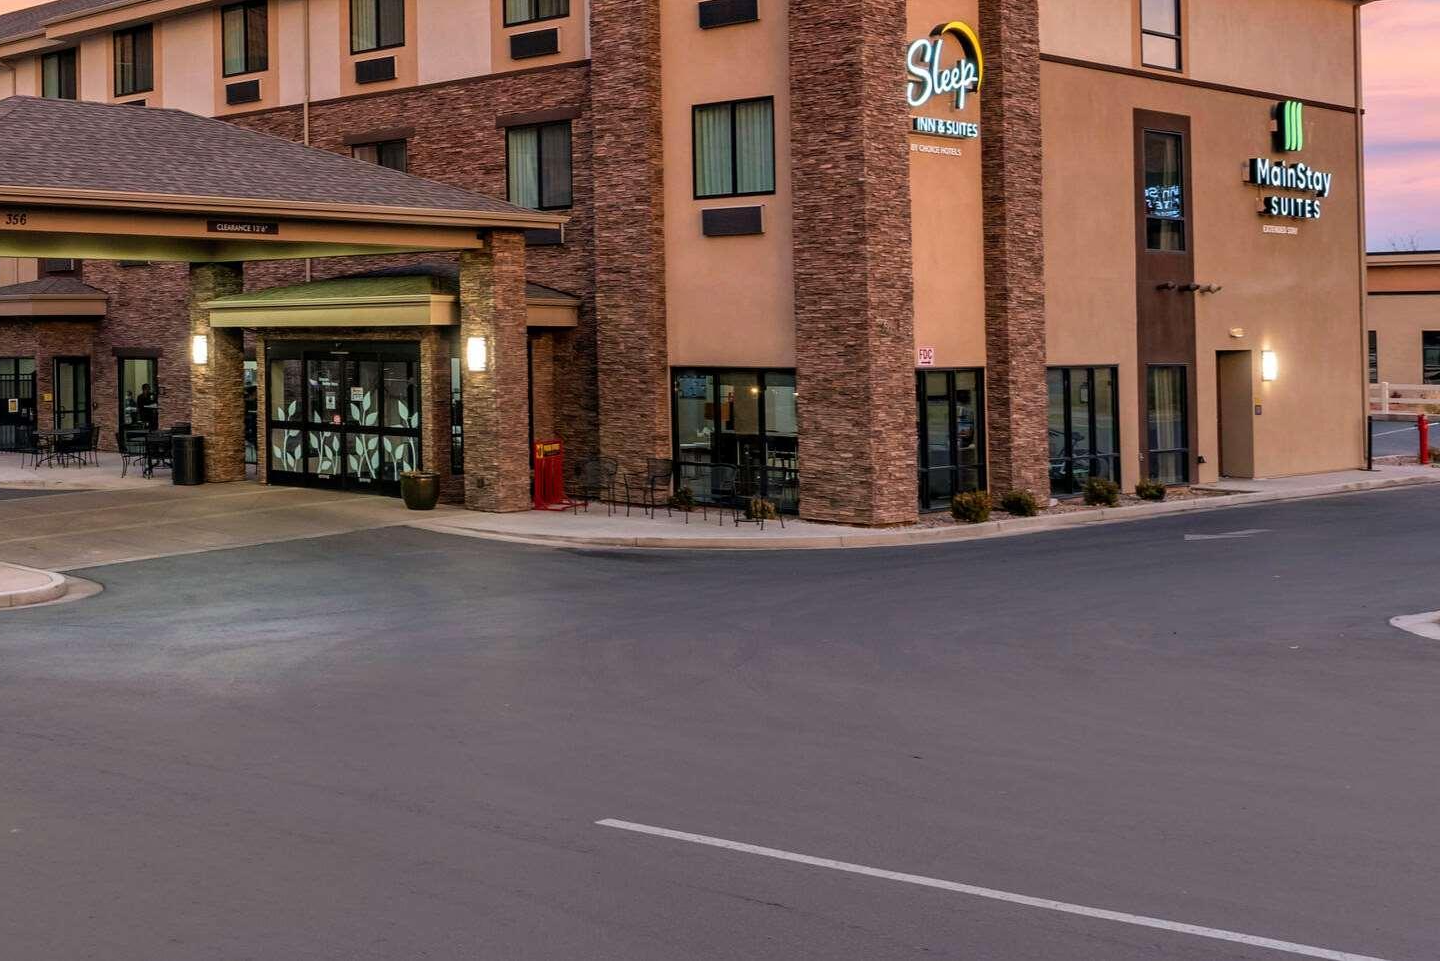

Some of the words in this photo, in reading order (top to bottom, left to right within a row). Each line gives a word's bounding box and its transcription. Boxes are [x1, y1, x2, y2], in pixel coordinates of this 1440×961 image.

[907, 39, 978, 110] Sleep
[917, 116, 936, 132] INN
[938, 119, 945, 133] &
[946, 120, 978, 138] SUITES
[1257, 158, 1332, 197] MainStay
[1271, 196, 1321, 219] SUITES
[6, 213, 27, 225] 356
[919, 349, 932, 360] FDC
